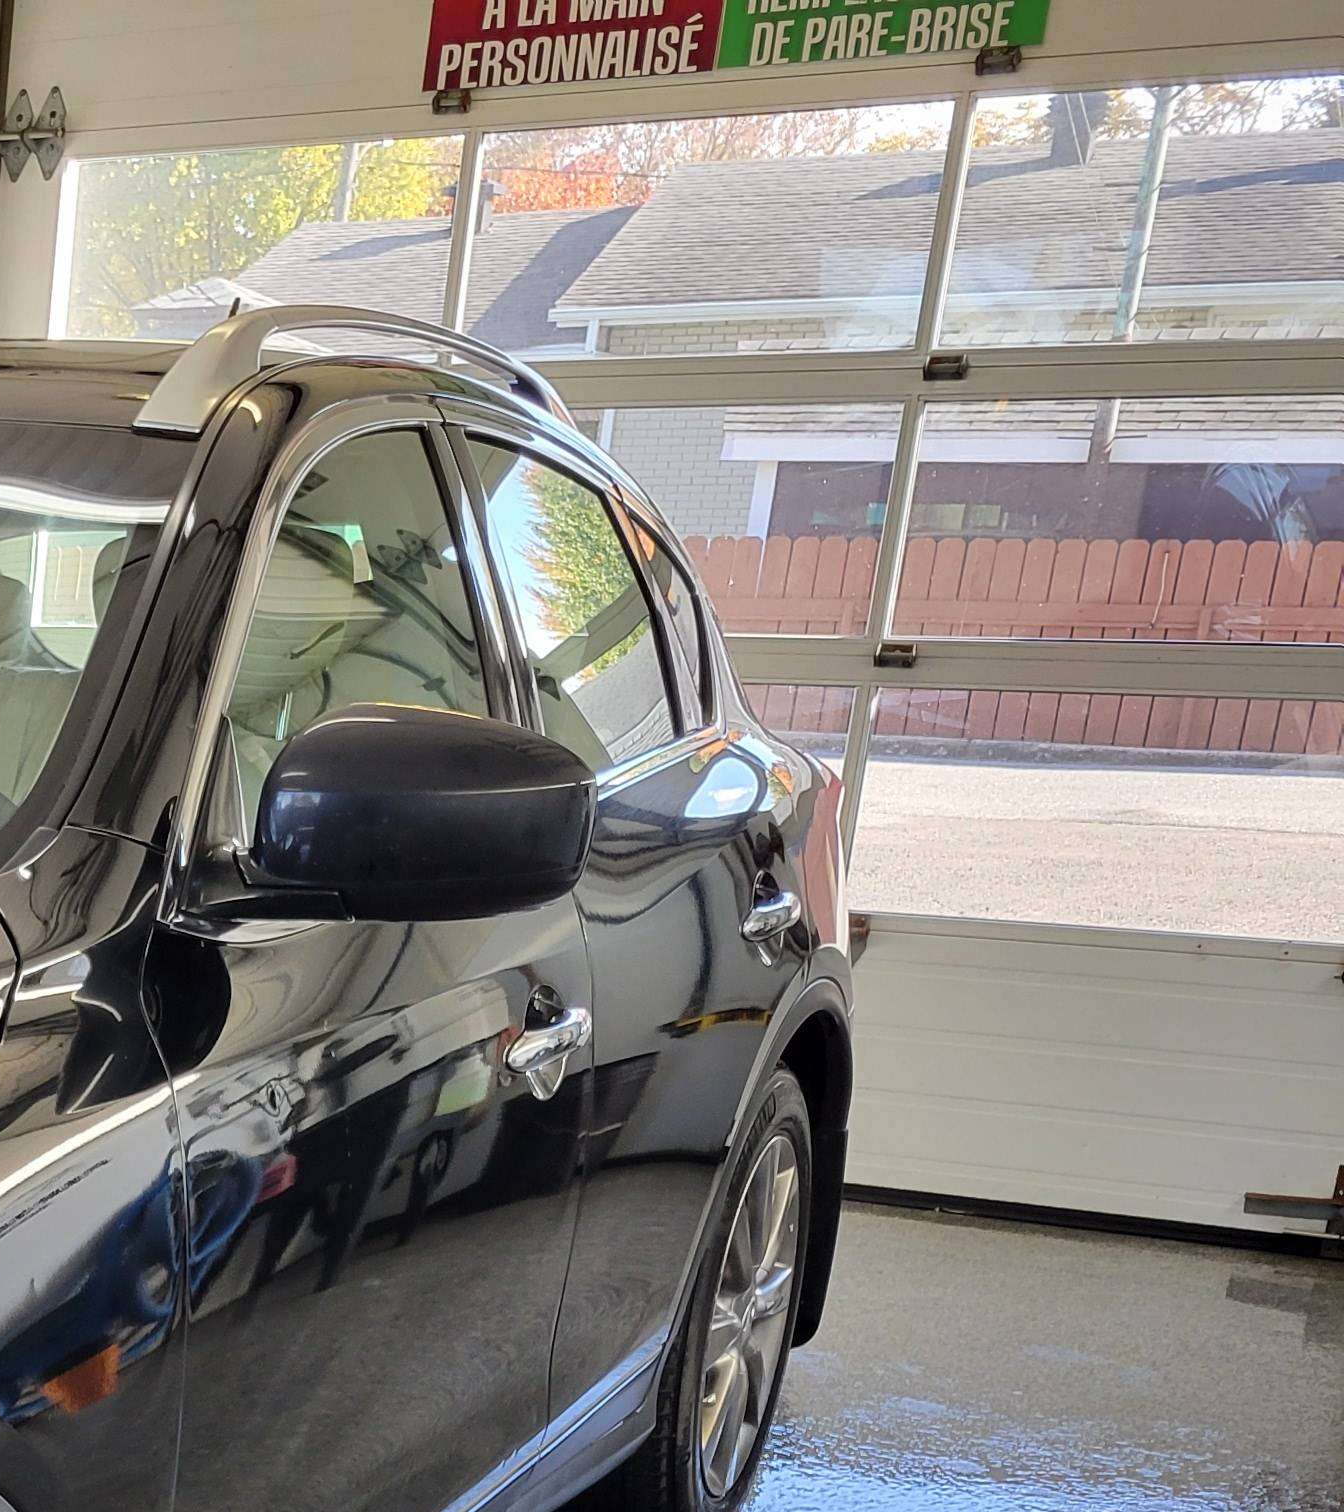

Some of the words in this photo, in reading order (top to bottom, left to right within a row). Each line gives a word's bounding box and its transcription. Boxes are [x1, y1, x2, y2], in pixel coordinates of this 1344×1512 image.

[437, 12, 704, 91] PERSONNALISÉ
[749, 20, 795, 67] DE
[801, 1, 1013, 62] PARE-BRISE
